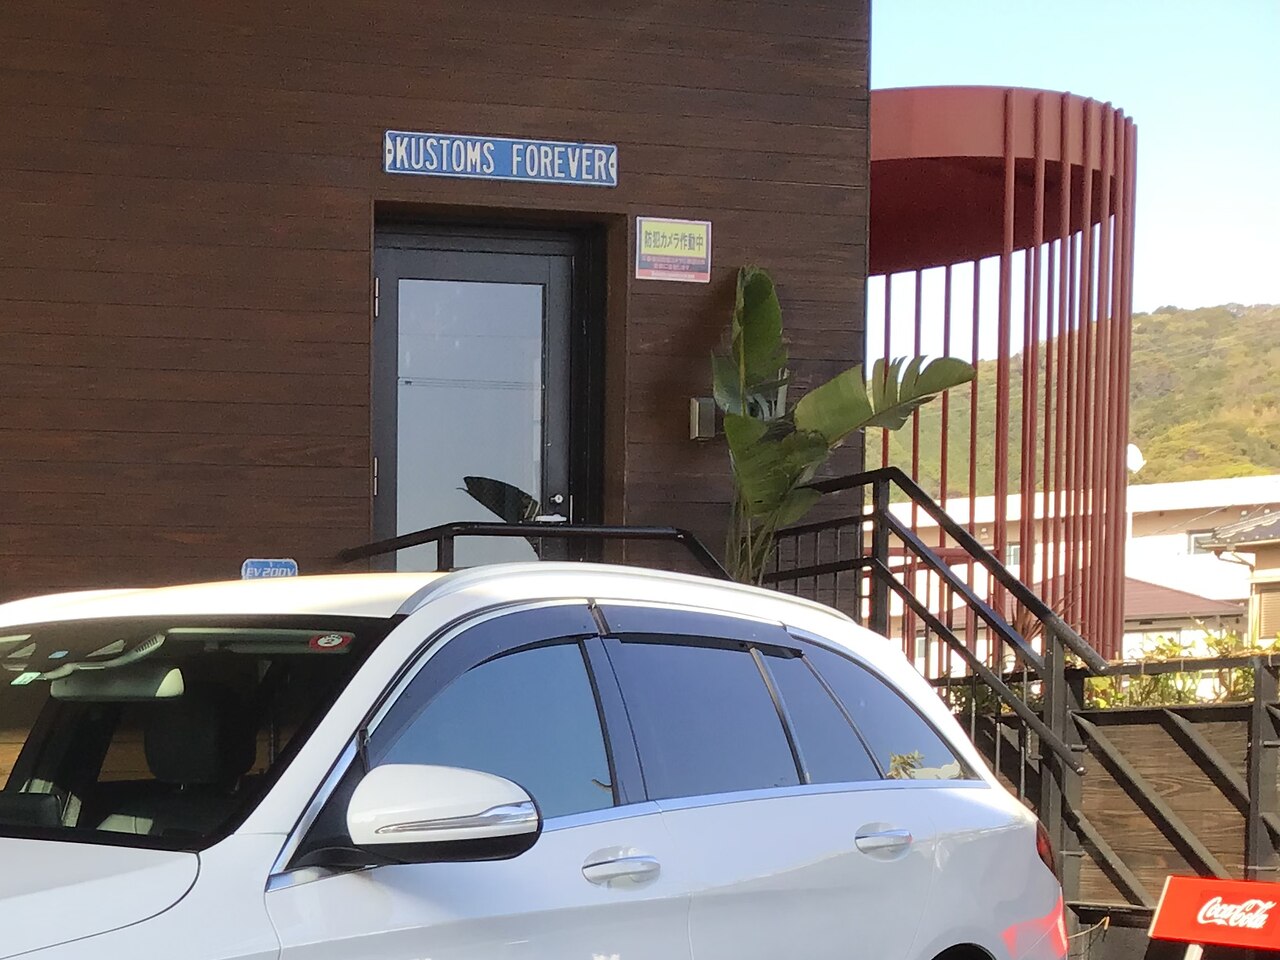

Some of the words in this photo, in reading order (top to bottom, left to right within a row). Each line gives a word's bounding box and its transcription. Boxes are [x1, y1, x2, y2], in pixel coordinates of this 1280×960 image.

[395, 136, 494, 174] KUSTOMS
[511, 144, 607, 180] FOREVER
[644, 230, 704, 251] 防犯カメラ作動中
